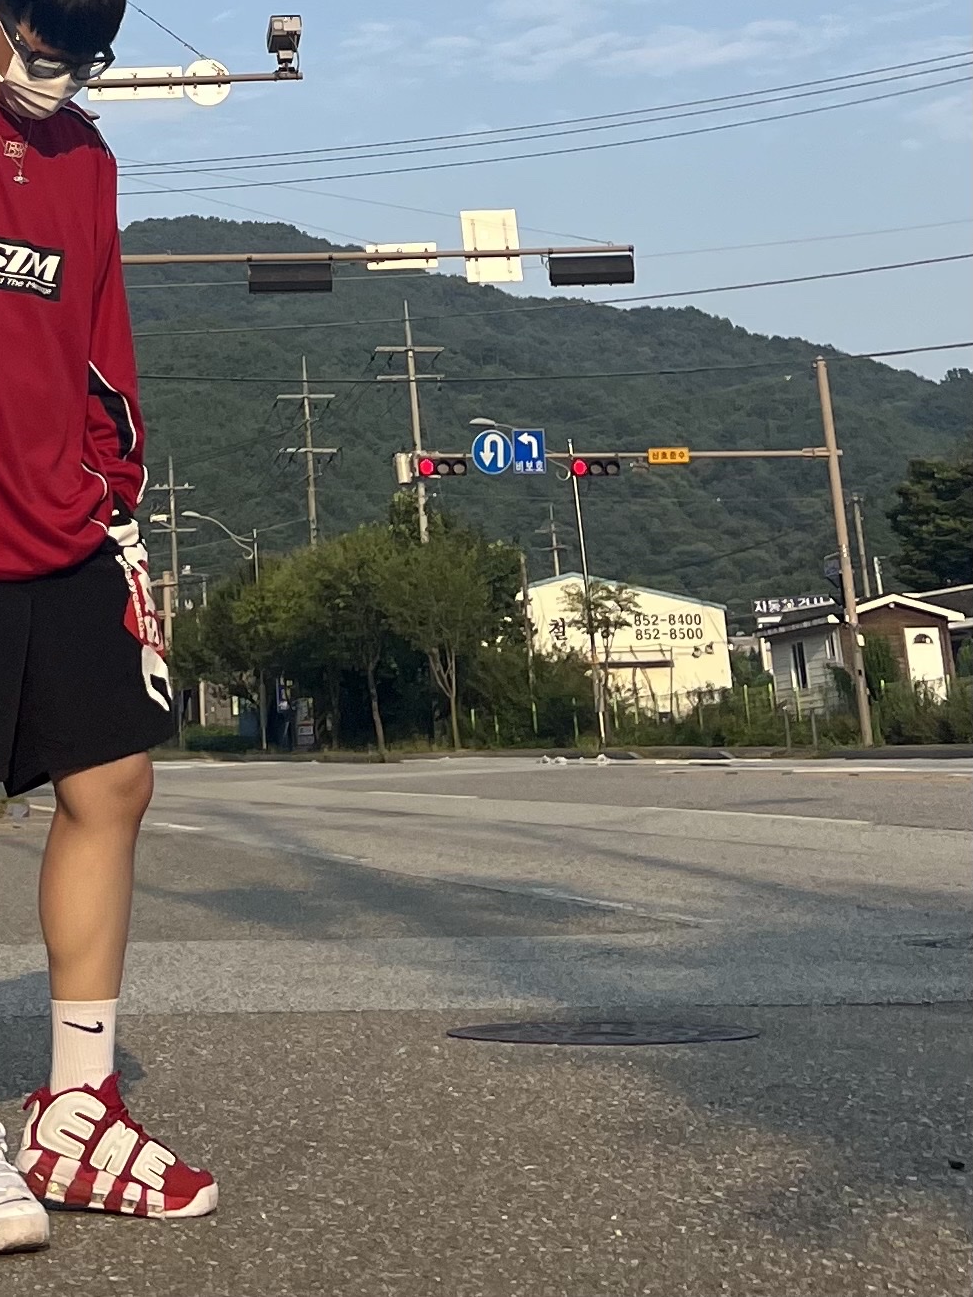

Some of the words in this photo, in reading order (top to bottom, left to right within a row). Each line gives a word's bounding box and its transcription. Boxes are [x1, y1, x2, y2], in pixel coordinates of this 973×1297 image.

[515, 460, 544, 472] 비보호
[634, 613, 702, 627] 852-8400
[635, 627, 704, 641] 852-8500
